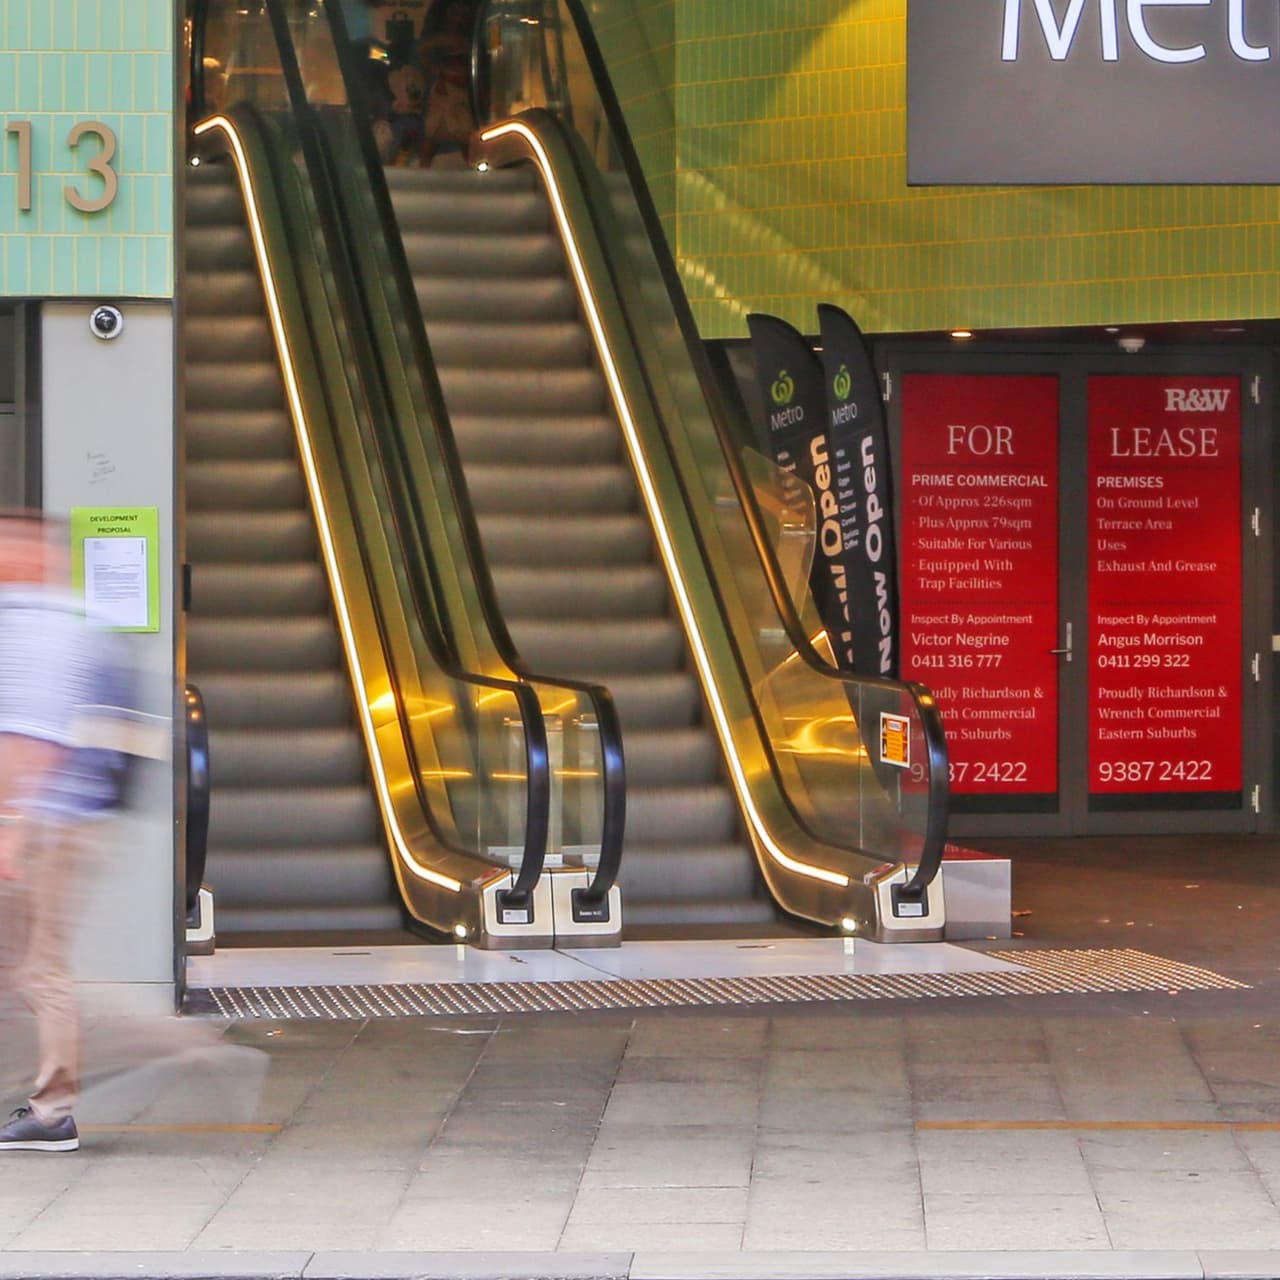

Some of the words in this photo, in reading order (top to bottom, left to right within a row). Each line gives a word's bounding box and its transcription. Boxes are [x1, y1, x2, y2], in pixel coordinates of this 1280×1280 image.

[1164, 388, 1230, 412] R&W
[771, 406, 804, 431] Metro
[832, 402, 858, 426] Metro
[946, 425, 1014, 455] FOR
[1110, 427, 1218, 457] LEASE
[911, 474, 954, 487] PRIME
[957, 474, 1048, 487] COMMERCIAL
[1096, 476, 1164, 489] PREMISES
[810, 434, 843, 557] Open
[861, 435, 884, 562] Open
[918, 495, 934, 507] Of
[935, 496, 979, 510] Approx
[983, 495, 1032, 510] 226sqm
[1097, 497, 1114, 508] On
[1118, 497, 1163, 509] Ground
[1166, 497, 1199, 509] Level
[919, 516, 944, 528] Plus
[946, 517, 989, 531] Approx
[992, 517, 1032, 531] 79sqm
[1097, 518, 1142, 529] Terrace
[1145, 518, 1172, 529] Area
[918, 538, 964, 550] Suitable
[967, 538, 986, 550] For
[988, 538, 1032, 550] Various
[1097, 539, 1127, 550] Uses
[919, 559, 980, 573] Equipped
[984, 559, 1013, 571] With
[1098, 560, 1146, 572] Exhaust
[1149, 560, 1172, 572] And
[1175, 560, 1217, 572] Grease
[918, 577, 946, 591] Trap
[949, 577, 1002, 589] Facilities
[874, 571, 892, 674] Now
[911, 614, 949, 625] Inspect
[951, 614, 964, 626] By
[966, 614, 1033, 625] Appointment
[1097, 615, 1135, 625] Inspect
[1136, 614, 1148, 626] By
[1151, 614, 1217, 625] Appointment
[911, 633, 952, 646] Victor
[956, 633, 1010, 648] Negrine
[1098, 633, 1141, 649] Angus
[1143, 633, 1203, 646] Morrison
[911, 655, 944, 668] 0411
[947, 655, 973, 668] 316
[976, 655, 1003, 668] 777
[1098, 655, 1131, 668] 0411
[1133, 655, 1161, 668] 299
[1163, 654, 1190, 667] 322
[962, 686, 1031, 699] Richardson
[1033, 687, 1045, 699] &
[1098, 686, 1144, 701] Proudly
[1147, 686, 1215, 699] Richardson
[1217, 686, 1228, 698] &
[962, 706, 1036, 719] Commercial
[1098, 706, 1145, 719] Wrench
[1147, 706, 1220, 718] Commercial
[961, 727, 1012, 740] Suburbs
[1098, 728, 1143, 740] Eastern
[1146, 726, 1197, 739] Suburbs
[973, 761, 1027, 782] 2422
[1099, 761, 1155, 782] 9387
[1159, 760, 1212, 780] 2422
